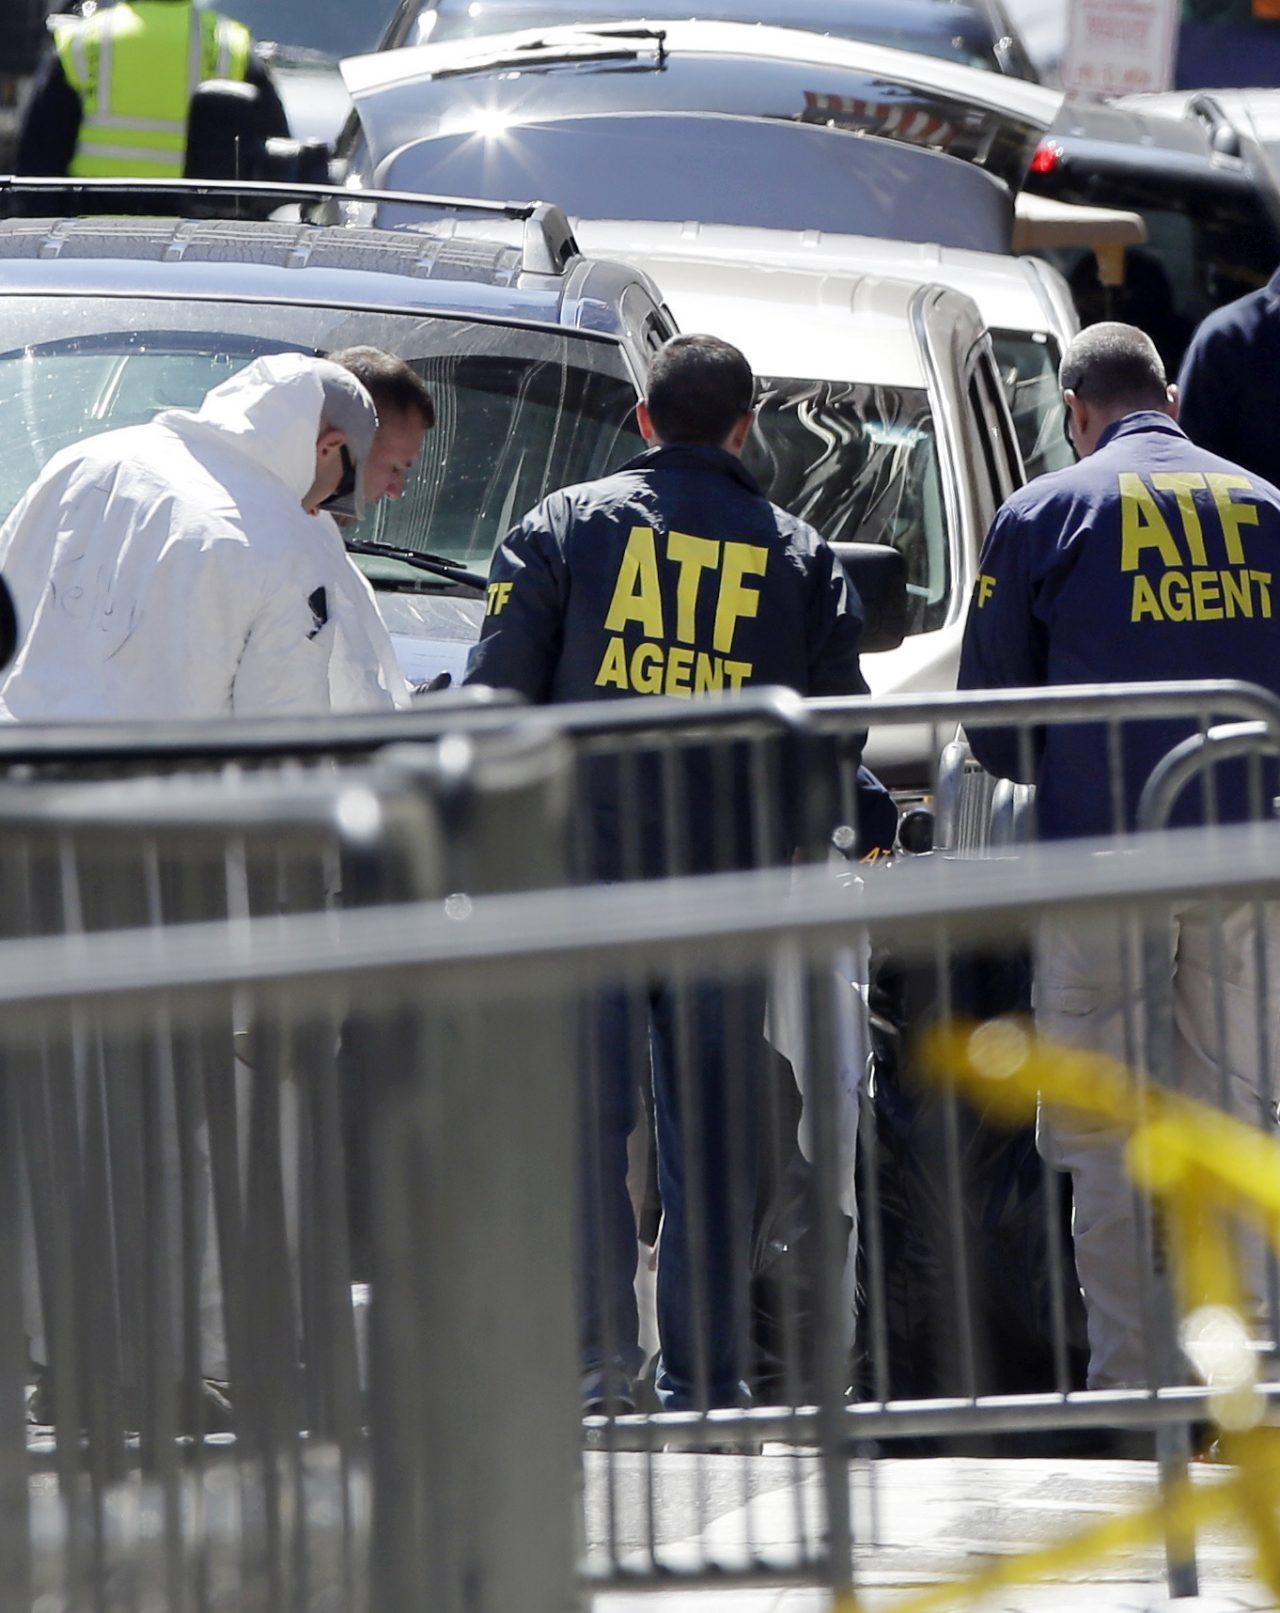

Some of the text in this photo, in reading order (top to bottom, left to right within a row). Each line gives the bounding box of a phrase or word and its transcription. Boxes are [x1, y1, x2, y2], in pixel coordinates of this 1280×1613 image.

[1117, 471, 1259, 572] ATF
[603, 526, 769, 654] ATF
[976, 574, 996, 608] F
[1130, 569, 1272, 623] AGENT
[594, 636, 753, 700] AGENT
